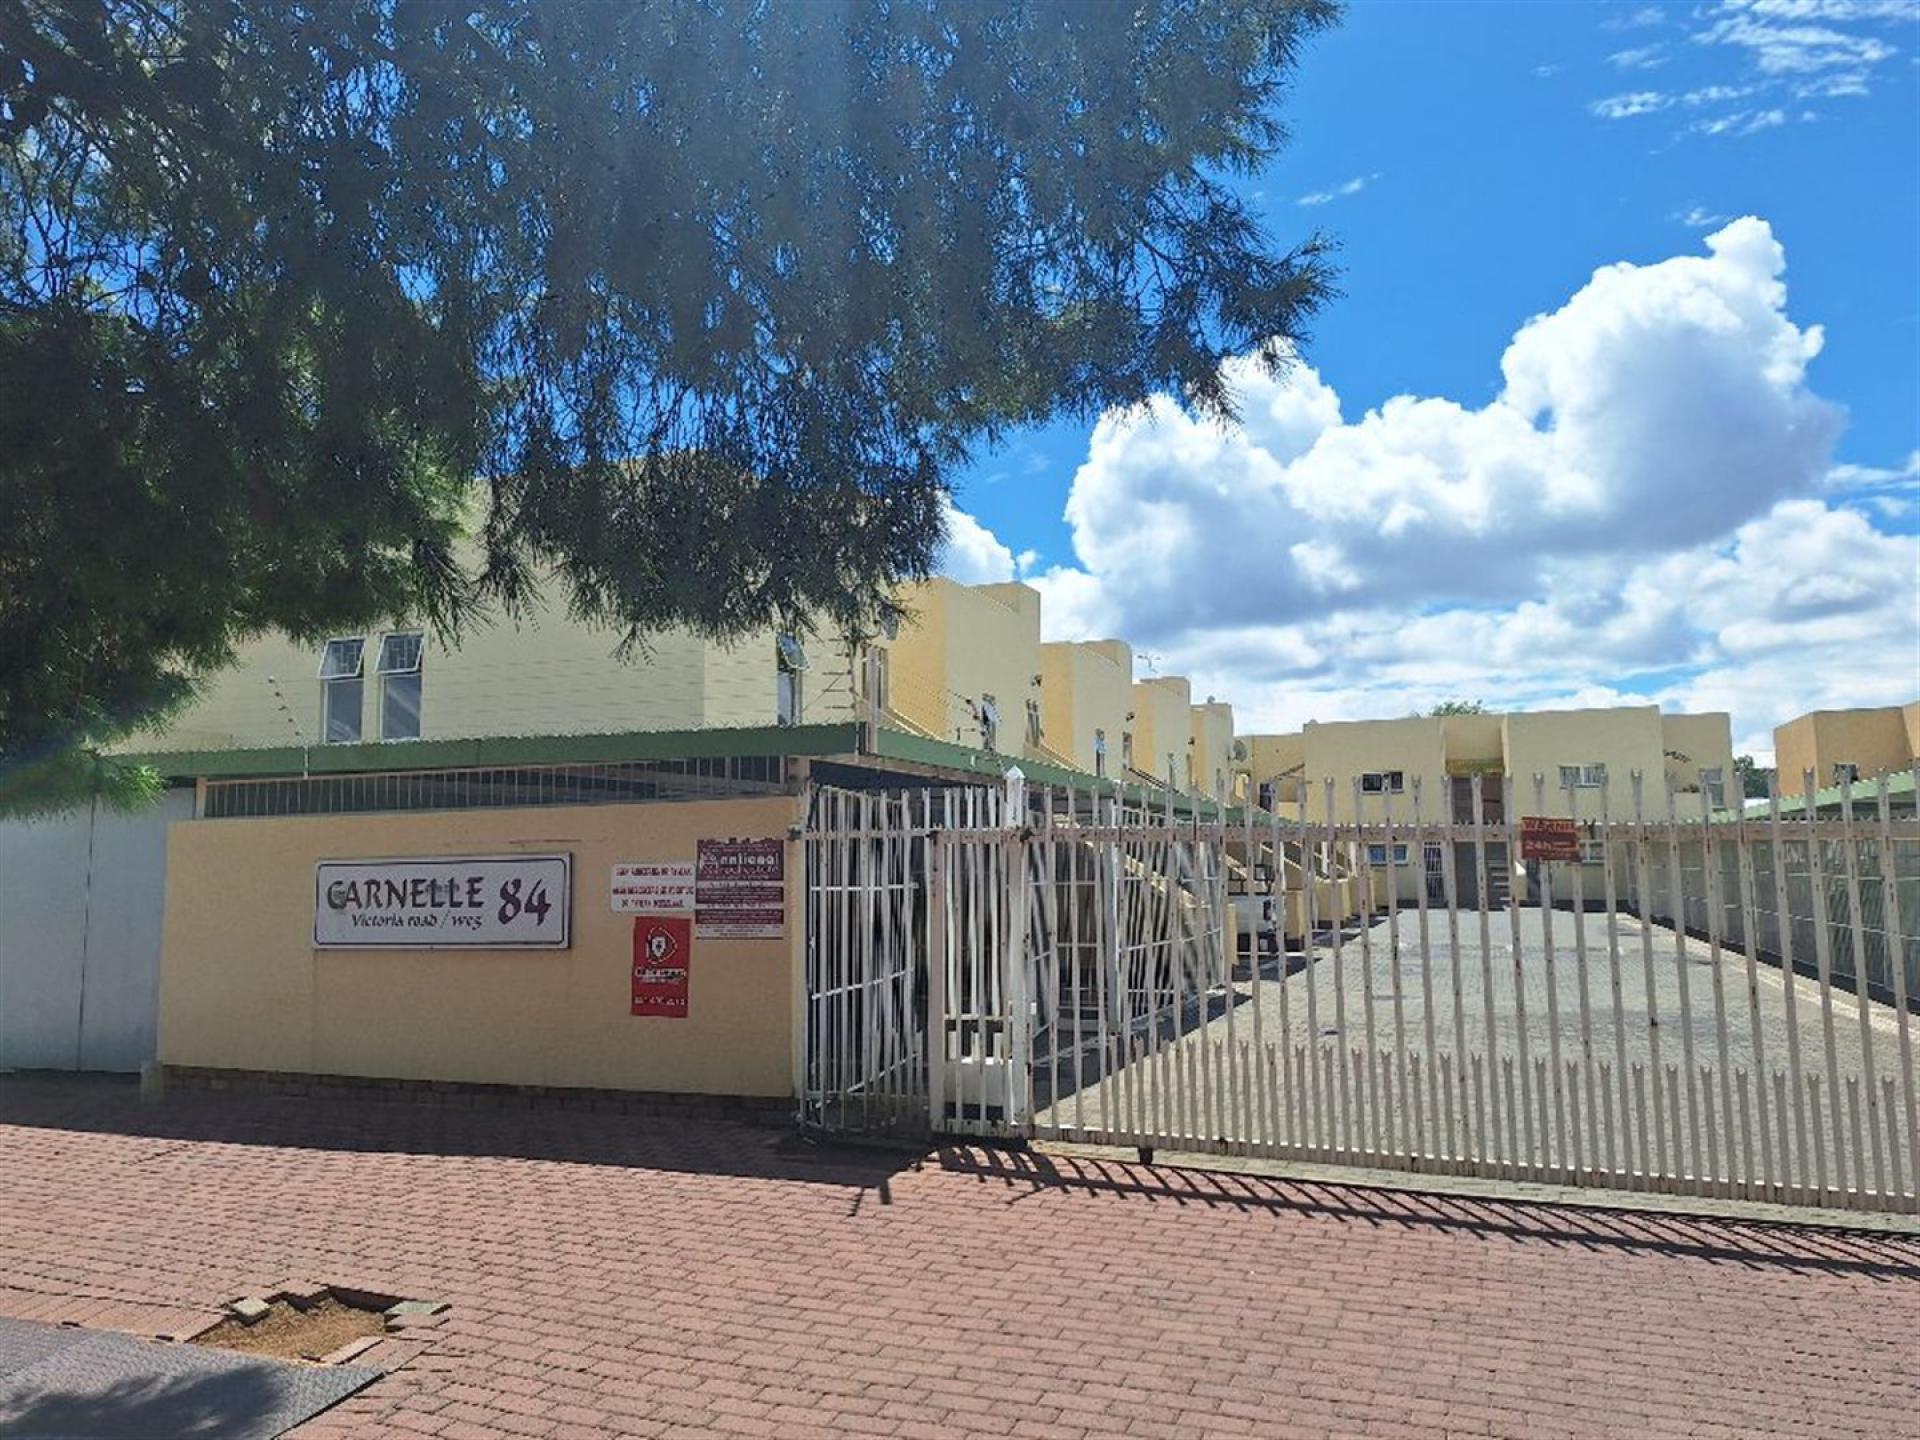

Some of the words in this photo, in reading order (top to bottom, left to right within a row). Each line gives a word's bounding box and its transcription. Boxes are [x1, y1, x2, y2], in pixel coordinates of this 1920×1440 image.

[327, 877, 484, 910] CARNELLE
[497, 878, 552, 926] 84
[351, 912, 404, 928] Victoria
[407, 914, 438, 928] road
